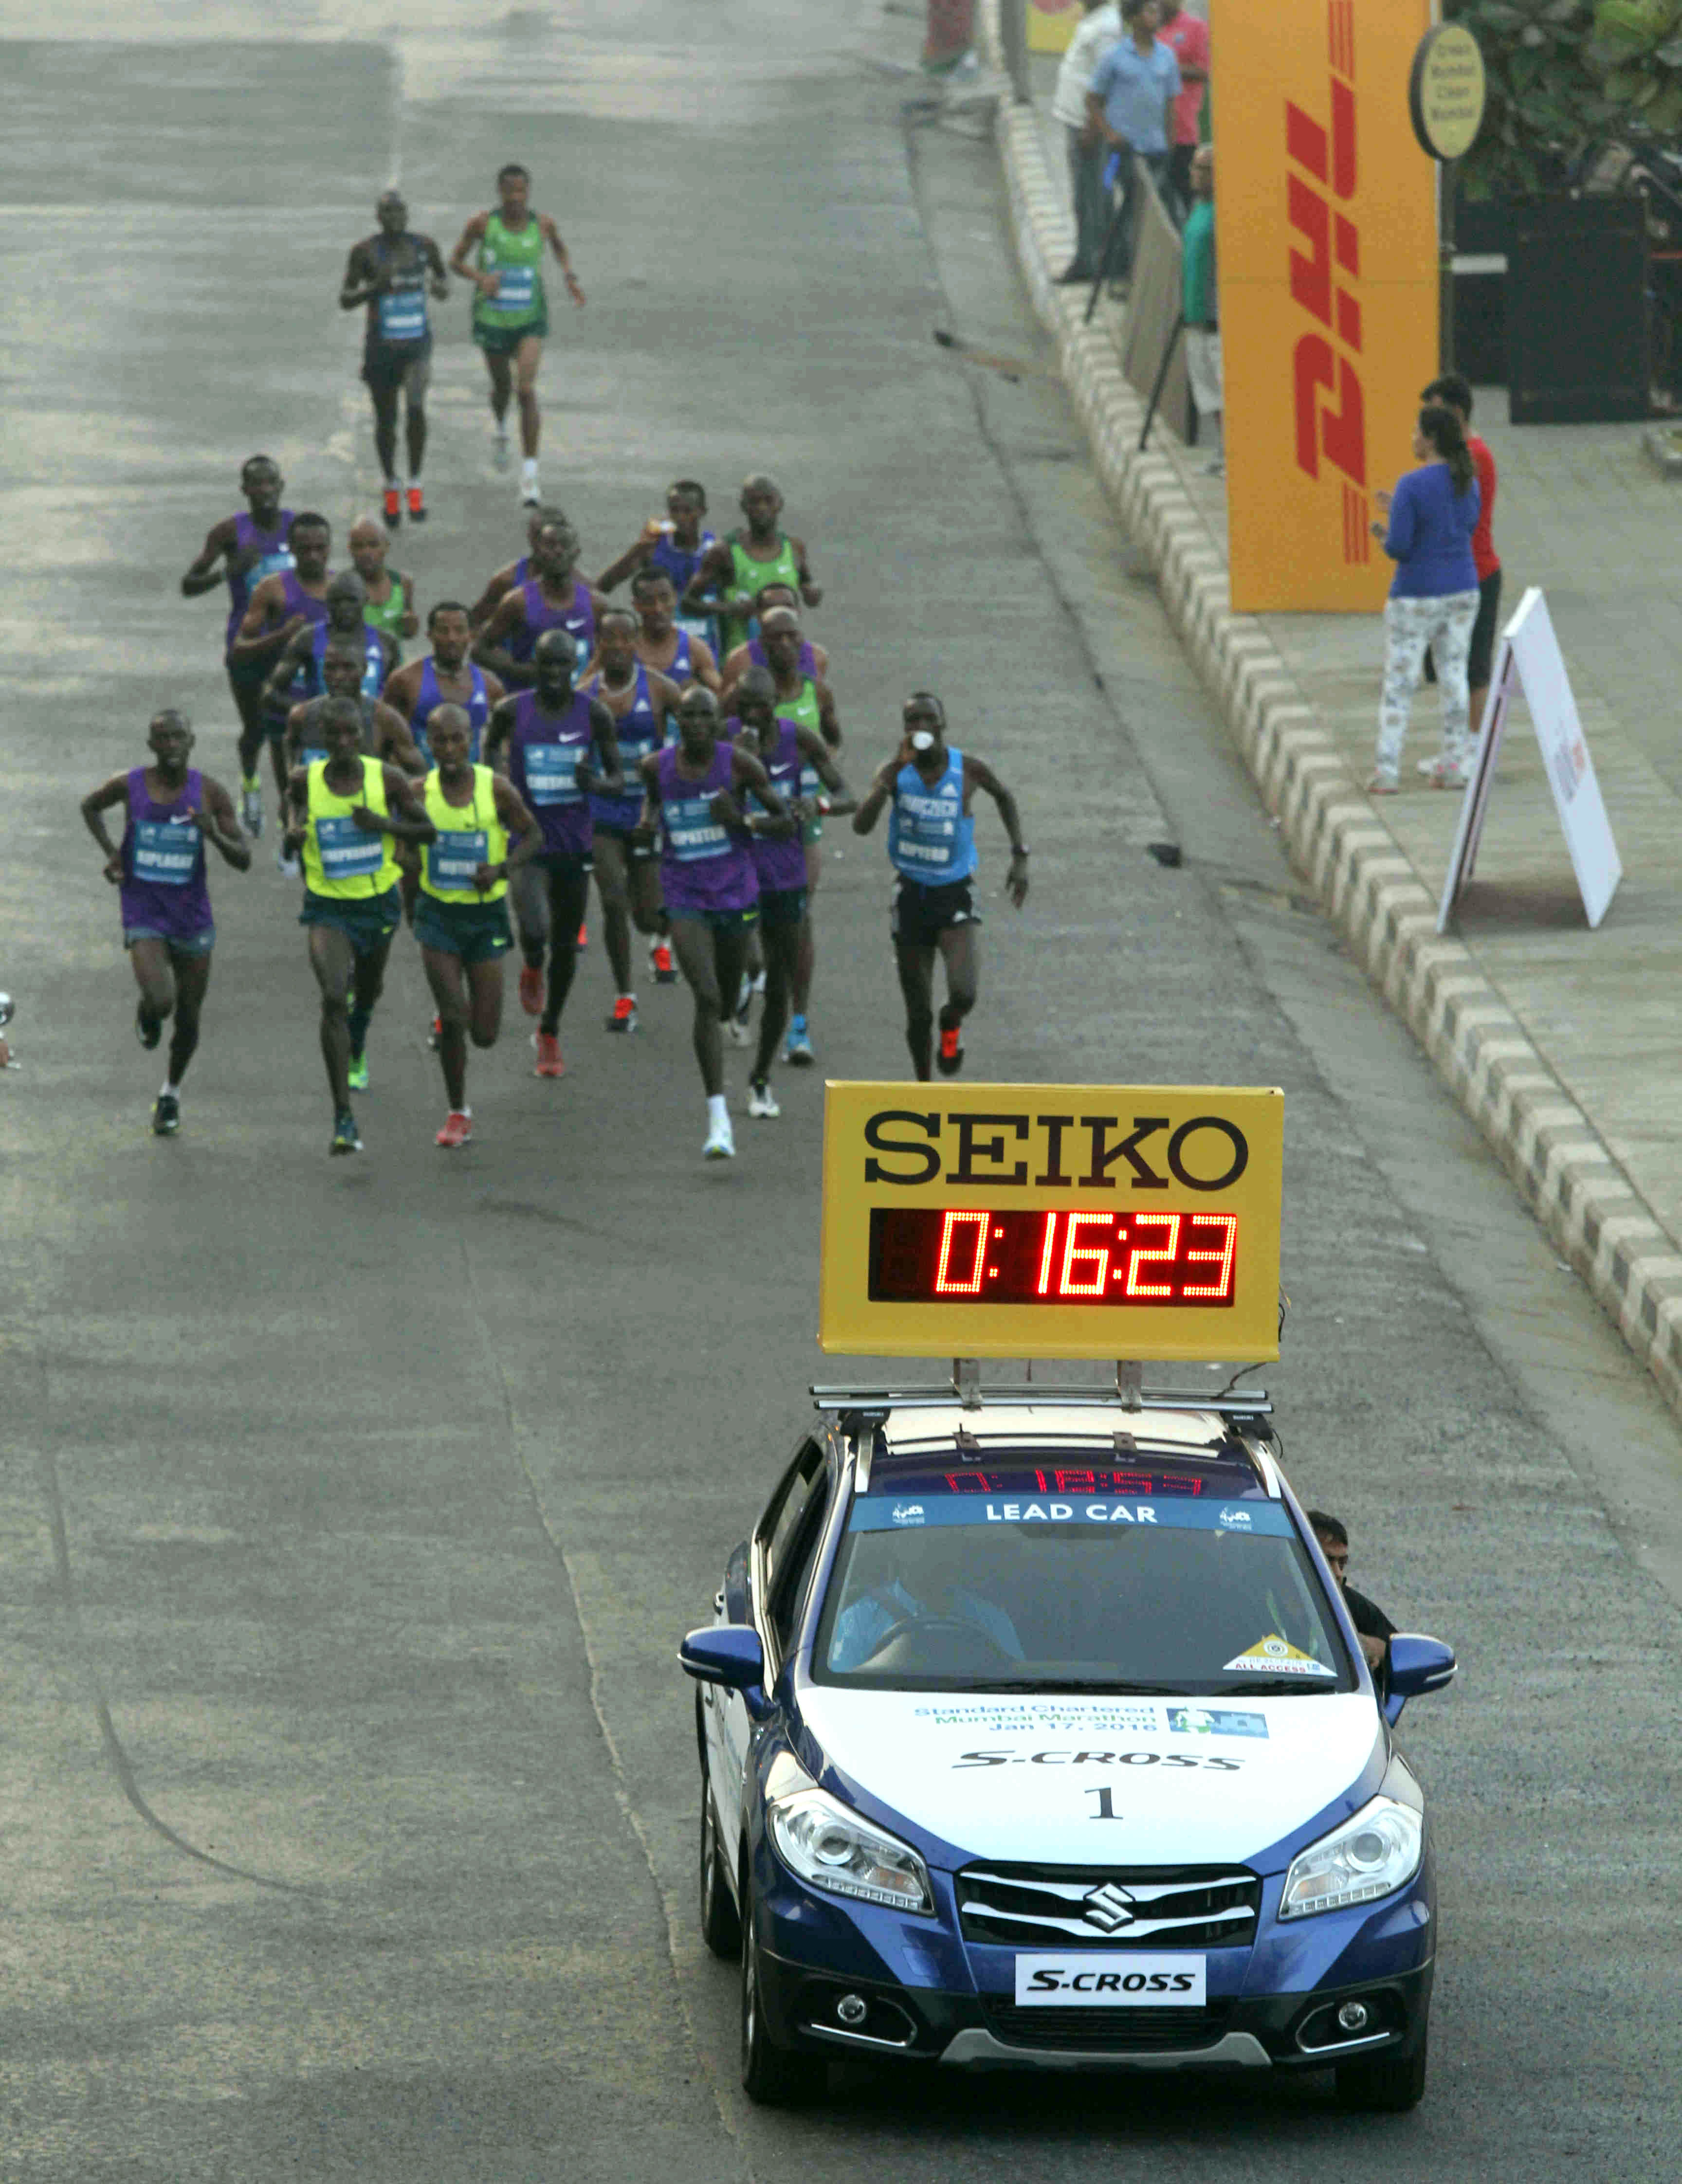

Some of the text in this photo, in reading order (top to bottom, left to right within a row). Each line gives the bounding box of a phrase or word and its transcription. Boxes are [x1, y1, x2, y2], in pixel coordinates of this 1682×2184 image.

[1285, 73, 1366, 490] DHL
[864, 1110, 1249, 1192] SEIKO
[986, 1503, 1158, 1523] LEAD CAR
[1261, 1664, 1306, 1673] ACCESS
[914, 1705, 1154, 1716] Standard Chartered
[935, 1714, 1156, 1724] Mumbai Marathon
[1094, 1723, 1157, 1731] 2016
[951, 1750, 1245, 1771] S-CROSS
[1084, 1786, 1123, 1820] 1
[1026, 1969, 1196, 1992] S-CROSS
